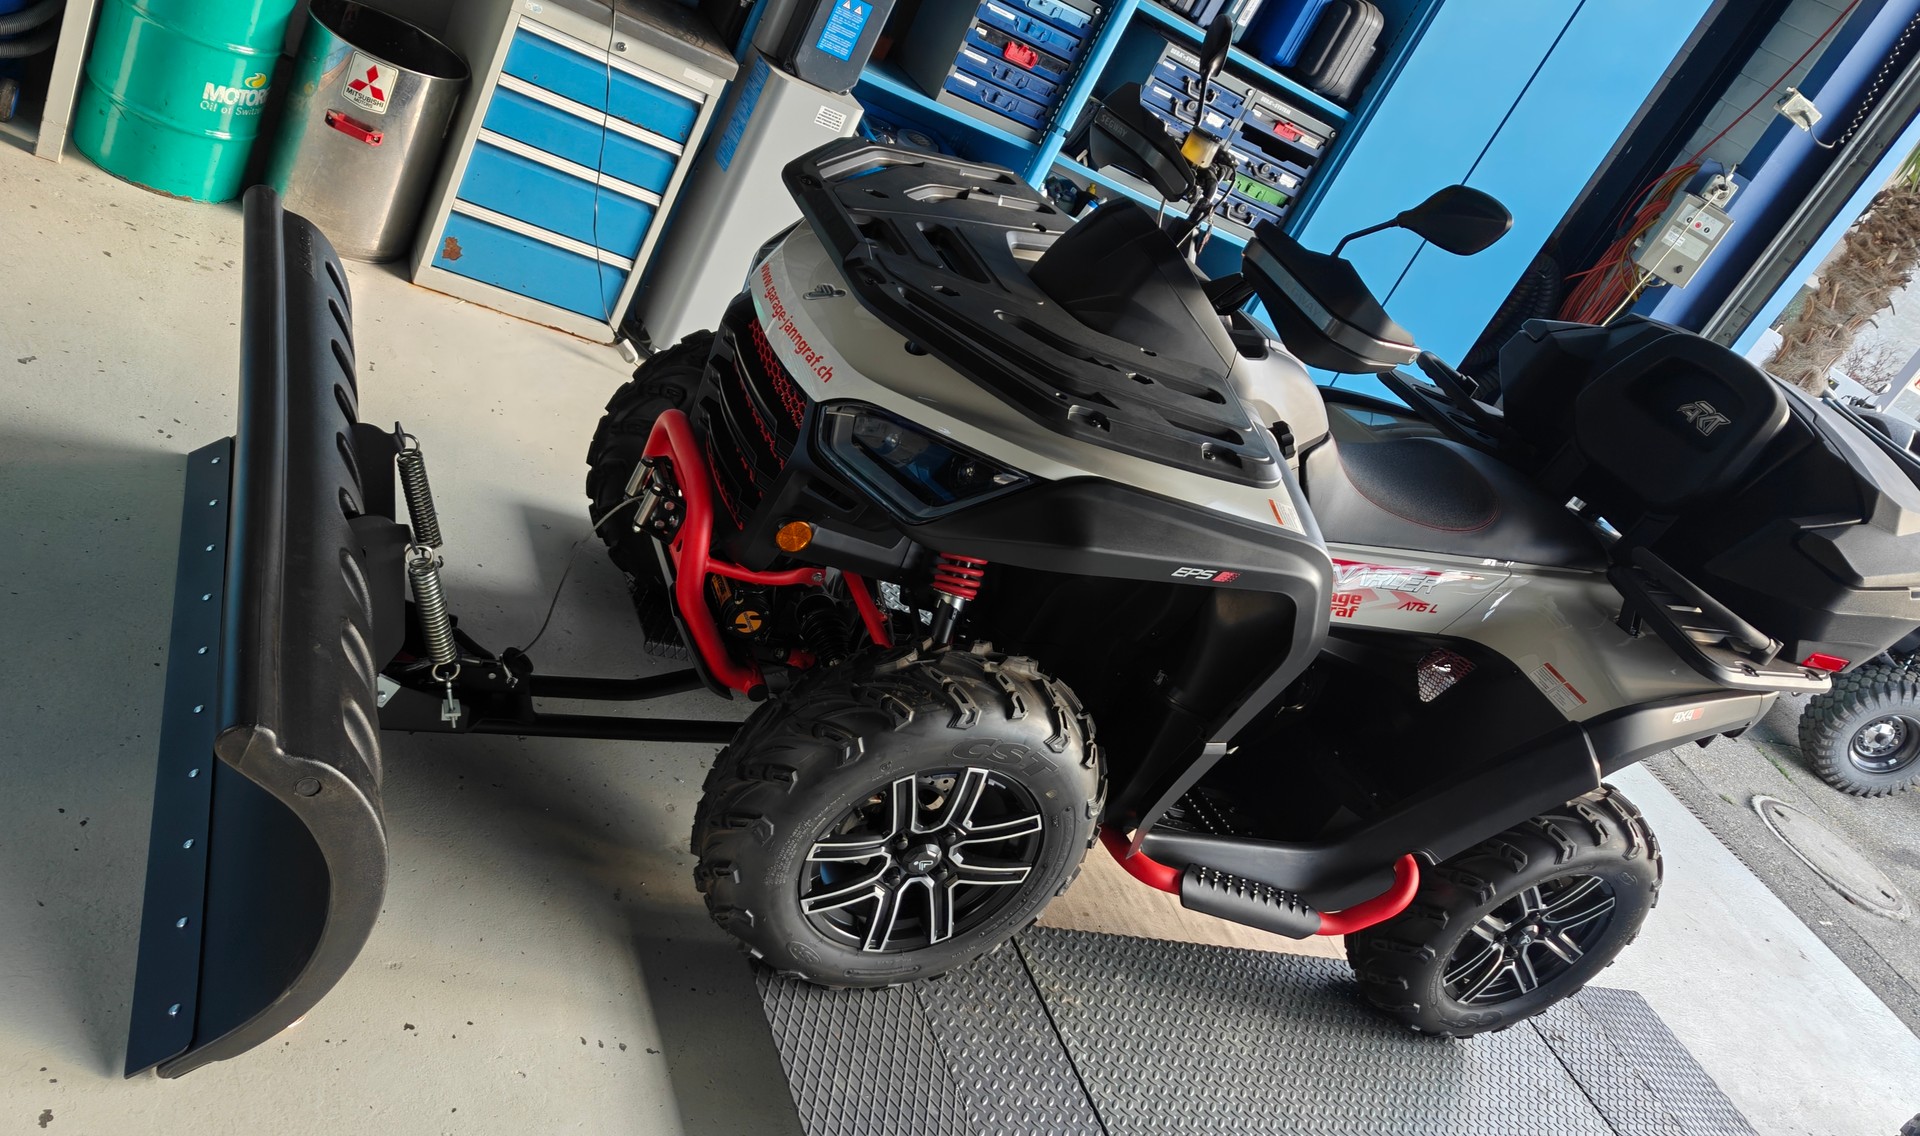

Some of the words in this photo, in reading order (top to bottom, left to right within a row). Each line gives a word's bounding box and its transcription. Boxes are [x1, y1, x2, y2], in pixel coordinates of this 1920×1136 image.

[200, 100, 218, 112] Oil
[221, 106, 233, 115] of
[345, 87, 385, 108] MITSUBISHI
[1101, 114, 1127, 137] SEGWAY
[761, 261, 835, 384] www.garage-janngraf.ch
[1170, 566, 1219, 580] EPS
[952, 737, 1060, 777] CST
